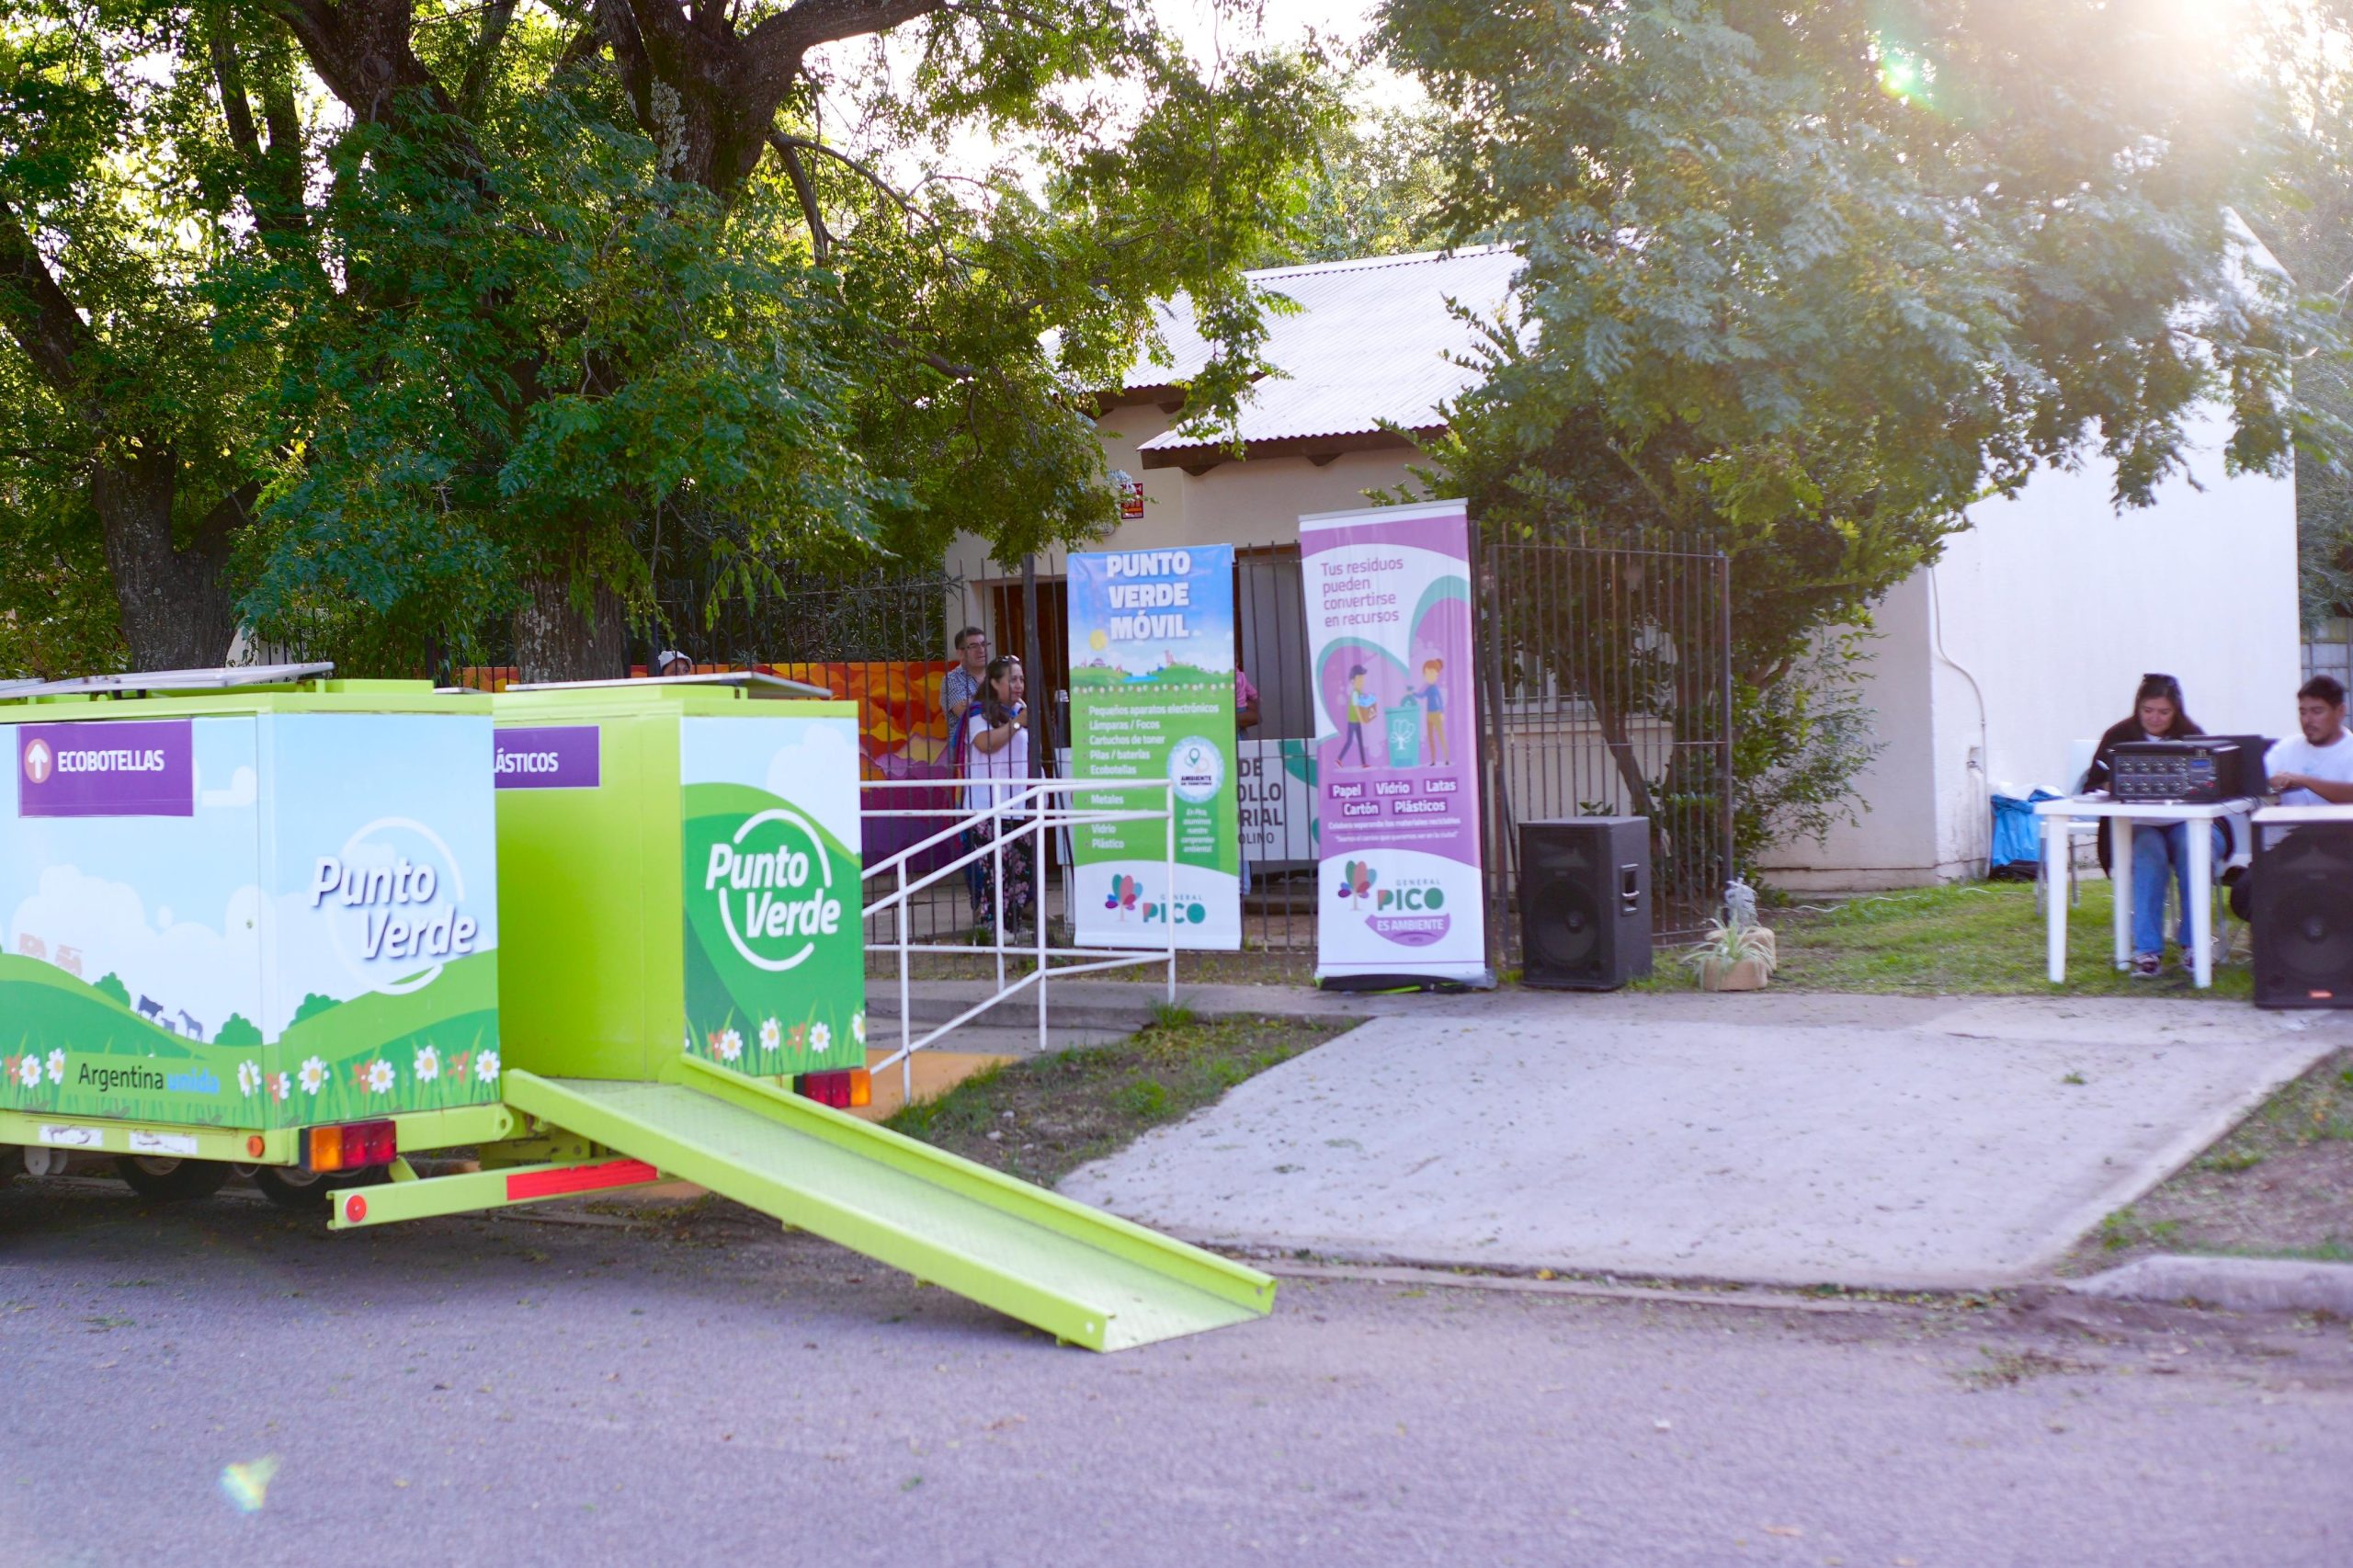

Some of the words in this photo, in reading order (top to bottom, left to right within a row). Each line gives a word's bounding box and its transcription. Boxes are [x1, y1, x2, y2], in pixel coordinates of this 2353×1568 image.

[1107, 551, 1191, 577] PUNTO
[1321, 562, 1343, 576] Tus
[1347, 557, 1404, 574] residuos
[1108, 582, 1189, 608] VERDE
[1323, 577, 1370, 597] pueden
[1324, 593, 1396, 610] convertirse
[1110, 610, 1189, 641] MÓVIL
[1324, 615, 1339, 627] en
[1343, 610, 1399, 626] recursos
[1088, 705, 1129, 717] Pequeños
[1130, 705, 1165, 716] aparatos
[1167, 702, 1219, 714] electrónicos
[1089, 720, 1130, 732] Lámparas
[1136, 720, 1160, 730] Focos
[1089, 734, 1130, 745] Cartuchos
[1131, 734, 1142, 744] de
[57, 749, 165, 772] ECOBOTELLAS
[494, 747, 559, 773] ÁSTICOS
[1090, 749, 1109, 760] Pilas
[1090, 764, 1137, 775] Ecobotellas
[1237, 783, 1281, 801] OLLO
[1333, 784, 1361, 799] Papel
[1376, 782, 1410, 795] Vidrio
[1426, 779, 1456, 792] Latas
[1091, 794, 1124, 804] Metales
[1344, 802, 1379, 815] Cartón
[1394, 800, 1446, 812] Plásticos
[1240, 808, 1283, 826] RIAL
[1091, 824, 1116, 834] Vidrio
[1238, 832, 1275, 844] OLINO
[1092, 838, 1125, 848] Plástico
[705, 843, 809, 890] Punto
[311, 855, 438, 908] Punto
[1377, 887, 1444, 911] PICO
[745, 888, 841, 938] Verde
[1142, 903, 1206, 924] PICO
[360, 904, 478, 960] Verde
[1377, 919, 1391, 931] ES
[1391, 918, 1444, 931] AMBIENTE
[78, 1062, 165, 1092] Argentina
[166, 1067, 221, 1095] unida
